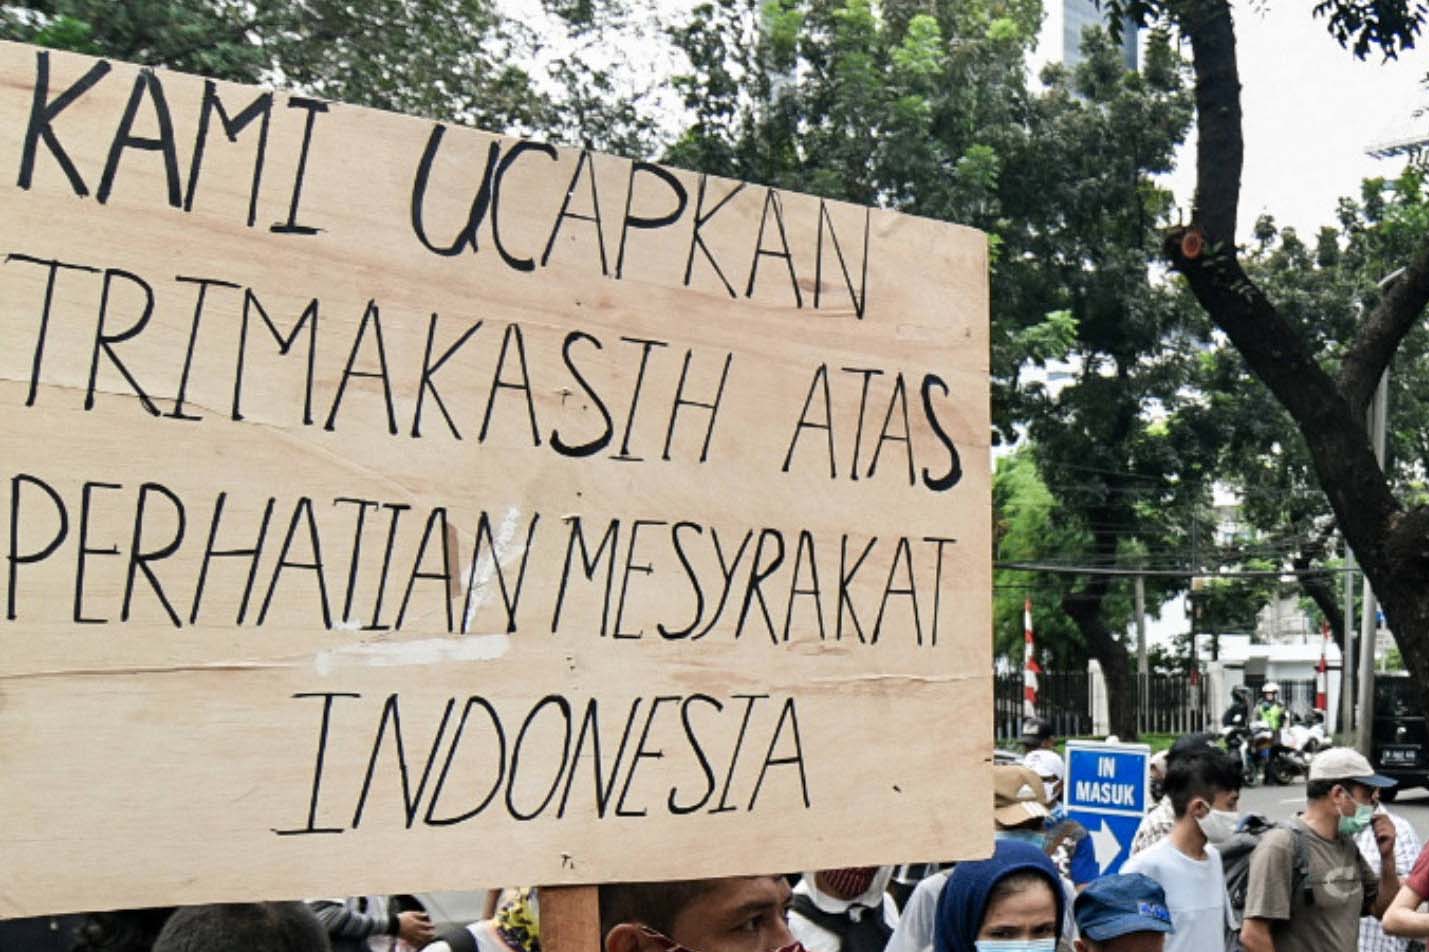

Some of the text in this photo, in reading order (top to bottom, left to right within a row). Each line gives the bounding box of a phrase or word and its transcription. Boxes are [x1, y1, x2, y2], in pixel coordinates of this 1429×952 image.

[17, 51, 870, 319] KAMI UCAPKAN
[3, 253, 963, 492] TRIMAKASIH ATAS
[6, 474, 957, 646] PERHATIAN MESYRAKAT
[271, 691, 812, 837] INDONESIA
[1075, 780, 1135, 807] MASUK
[1097, 756, 1116, 779] IN
